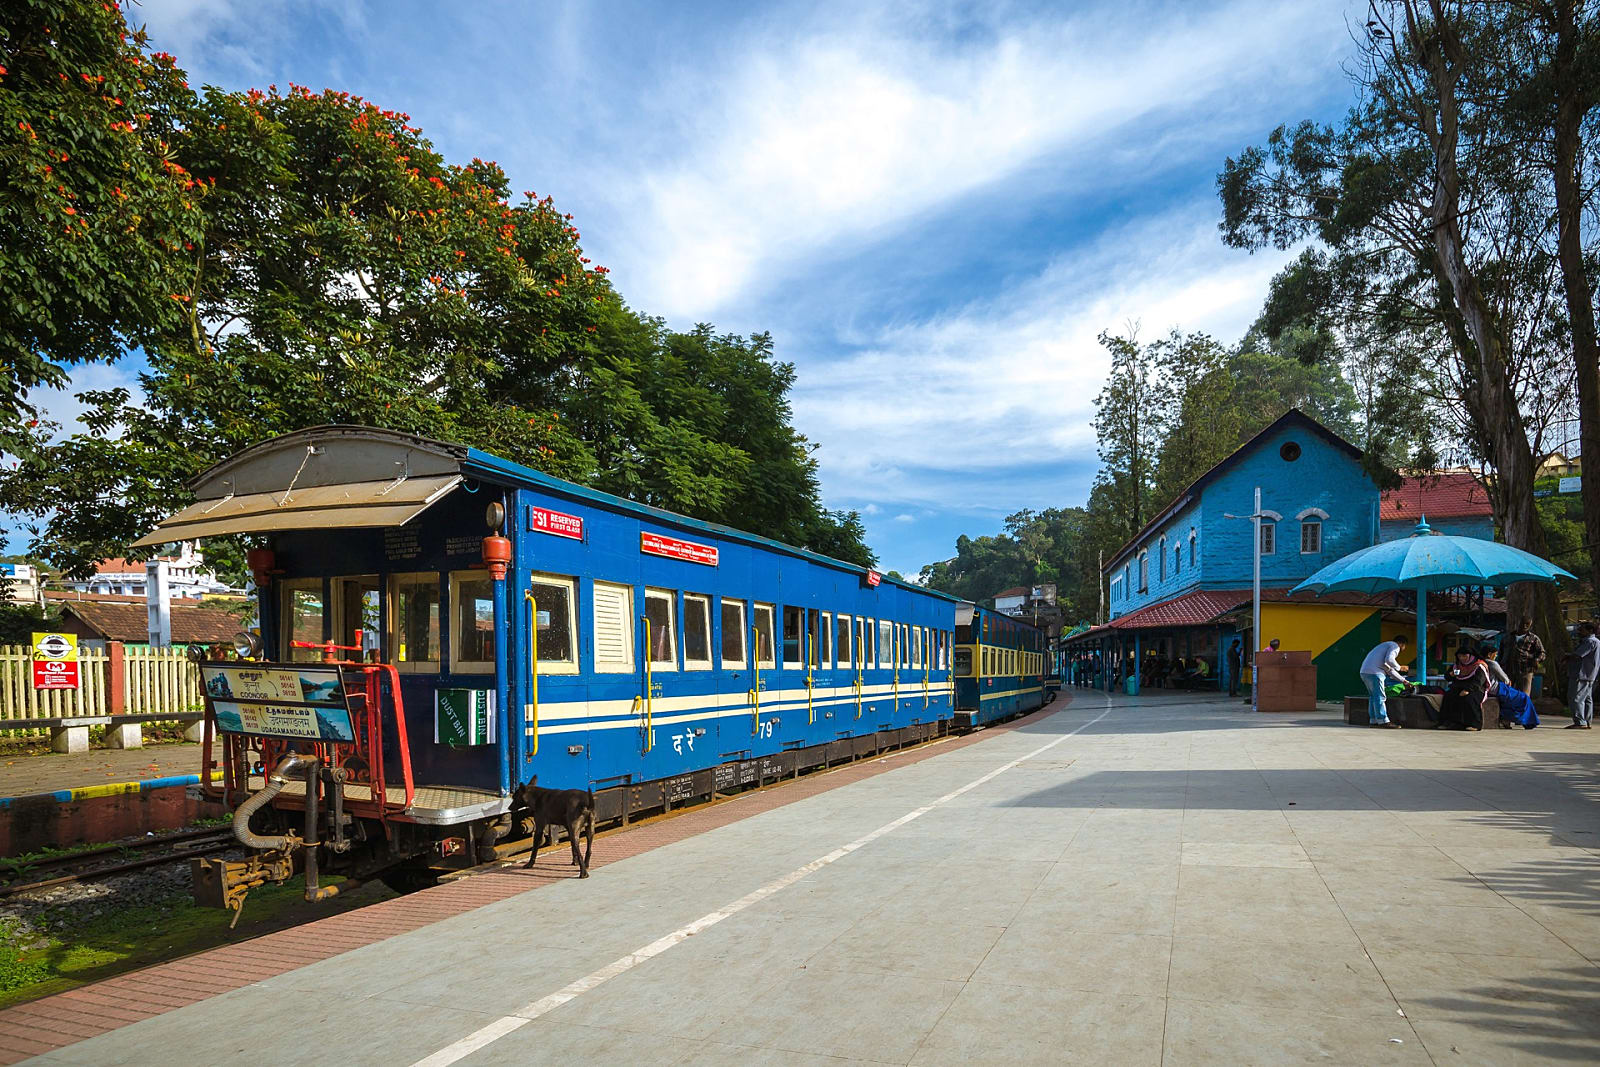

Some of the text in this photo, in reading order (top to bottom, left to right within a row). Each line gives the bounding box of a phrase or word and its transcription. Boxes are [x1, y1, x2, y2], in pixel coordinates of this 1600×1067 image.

[551, 514, 580, 527] RESERVED
[551, 523, 565, 531] FIRST
[240, 692, 269, 700] COONOOR
[440, 696, 466, 738] DUST BIN
[478, 690, 487, 735] DUST BIN
[261, 726, 316, 736] UDAGAMANDALAM
[759, 721, 772, 739] 79
